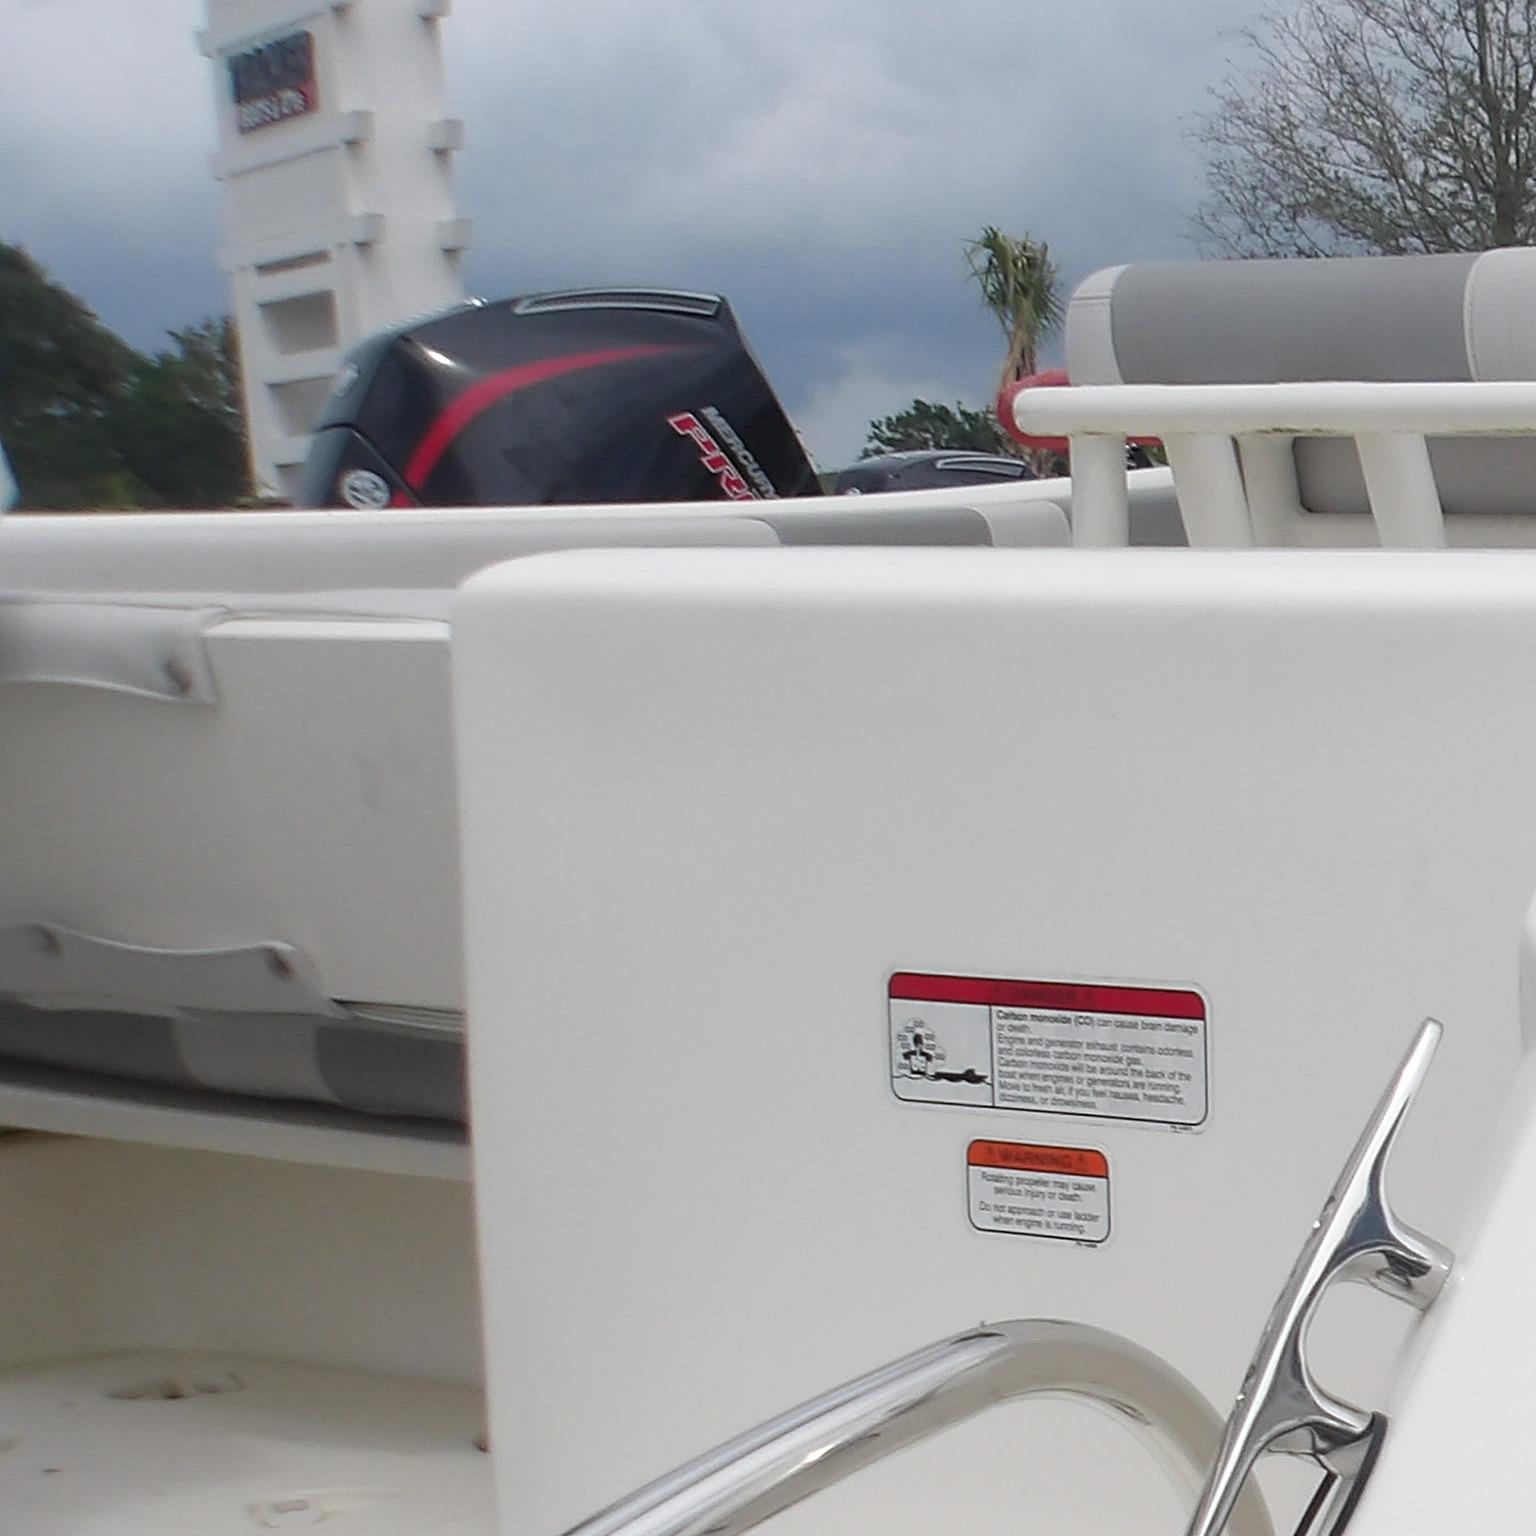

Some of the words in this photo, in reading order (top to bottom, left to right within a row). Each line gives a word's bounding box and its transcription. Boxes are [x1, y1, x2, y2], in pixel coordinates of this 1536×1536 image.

[1030, 1013, 1072, 1025] monoxide
[1074, 1015, 1095, 1028] (CO)
[1001, 1148, 1073, 1168] WARNING
